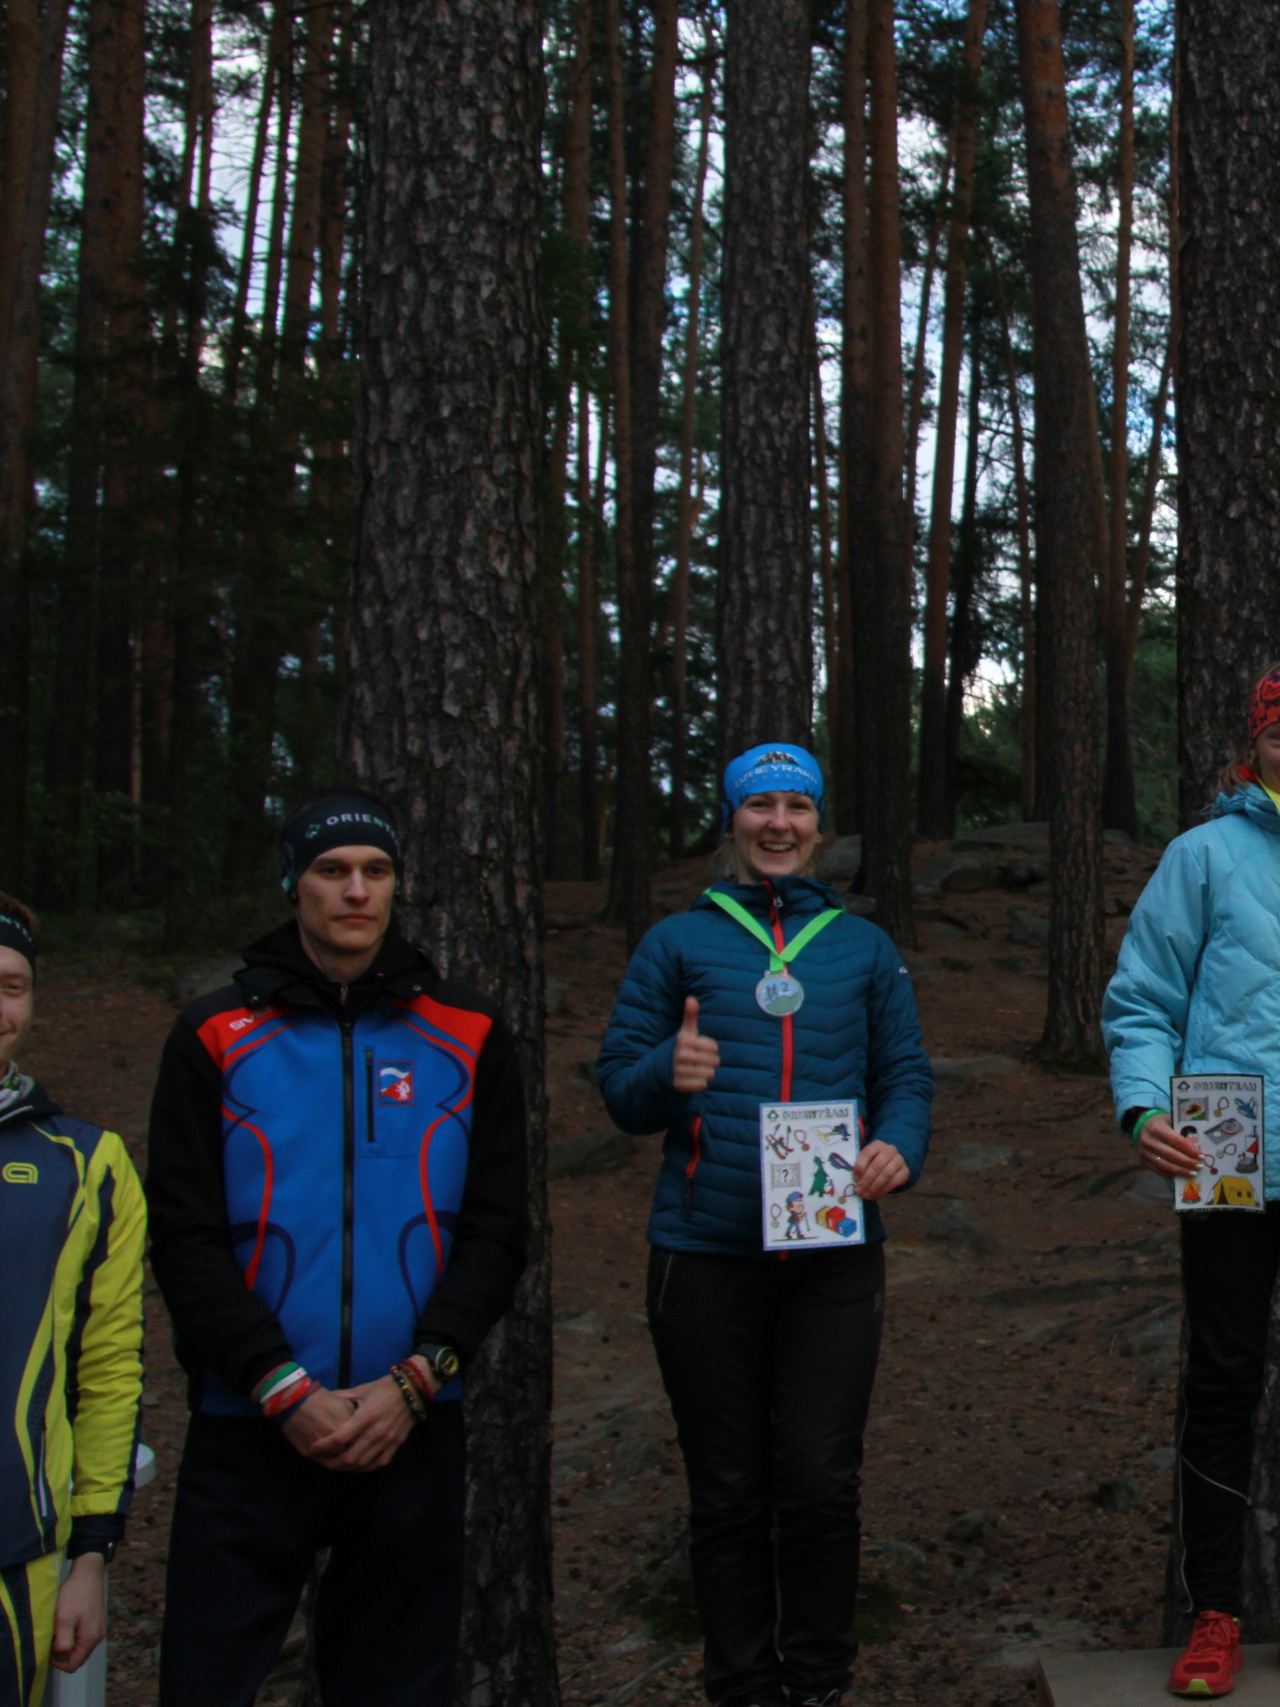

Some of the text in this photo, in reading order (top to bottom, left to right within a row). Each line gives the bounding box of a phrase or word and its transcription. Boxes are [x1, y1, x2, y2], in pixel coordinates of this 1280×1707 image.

[781, 983, 789, 992] 2
[1193, 1082, 1256, 1092] ORIENTEAM
[782, 1109, 848, 1120] ORIENTEAM
